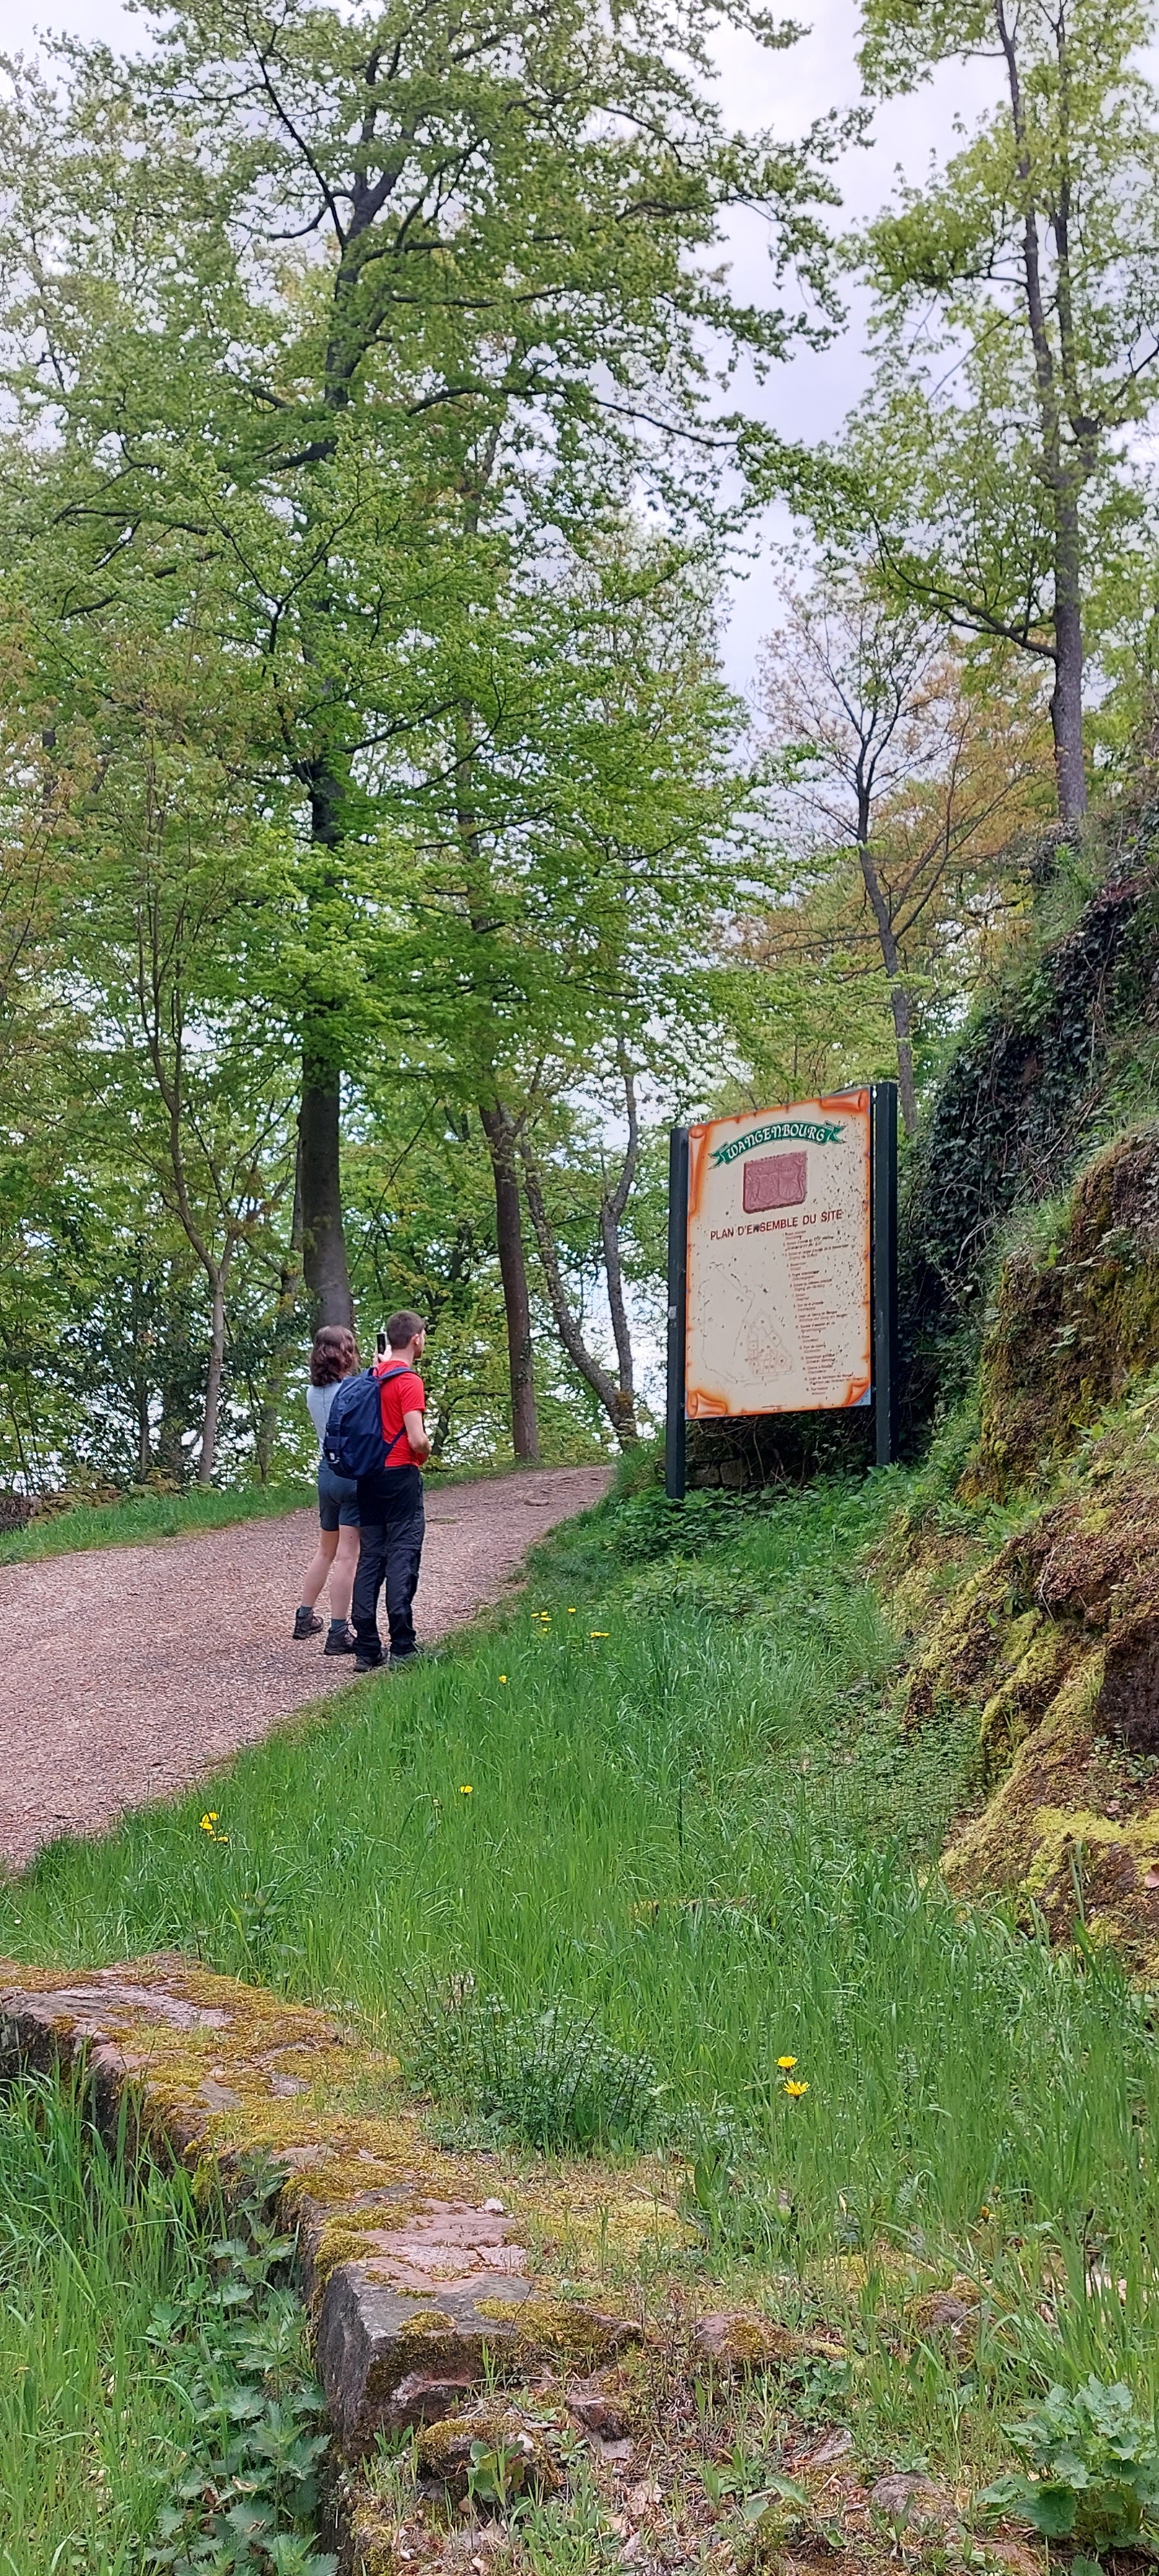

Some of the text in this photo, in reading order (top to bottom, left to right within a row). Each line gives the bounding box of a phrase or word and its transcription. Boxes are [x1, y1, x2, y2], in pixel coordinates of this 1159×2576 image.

[726, 1124, 825, 1159] WANGENBOURG
[710, 1227, 734, 1240] PLAN
[802, 1214, 817, 1225] DU
[821, 1209, 843, 1222] SITE
